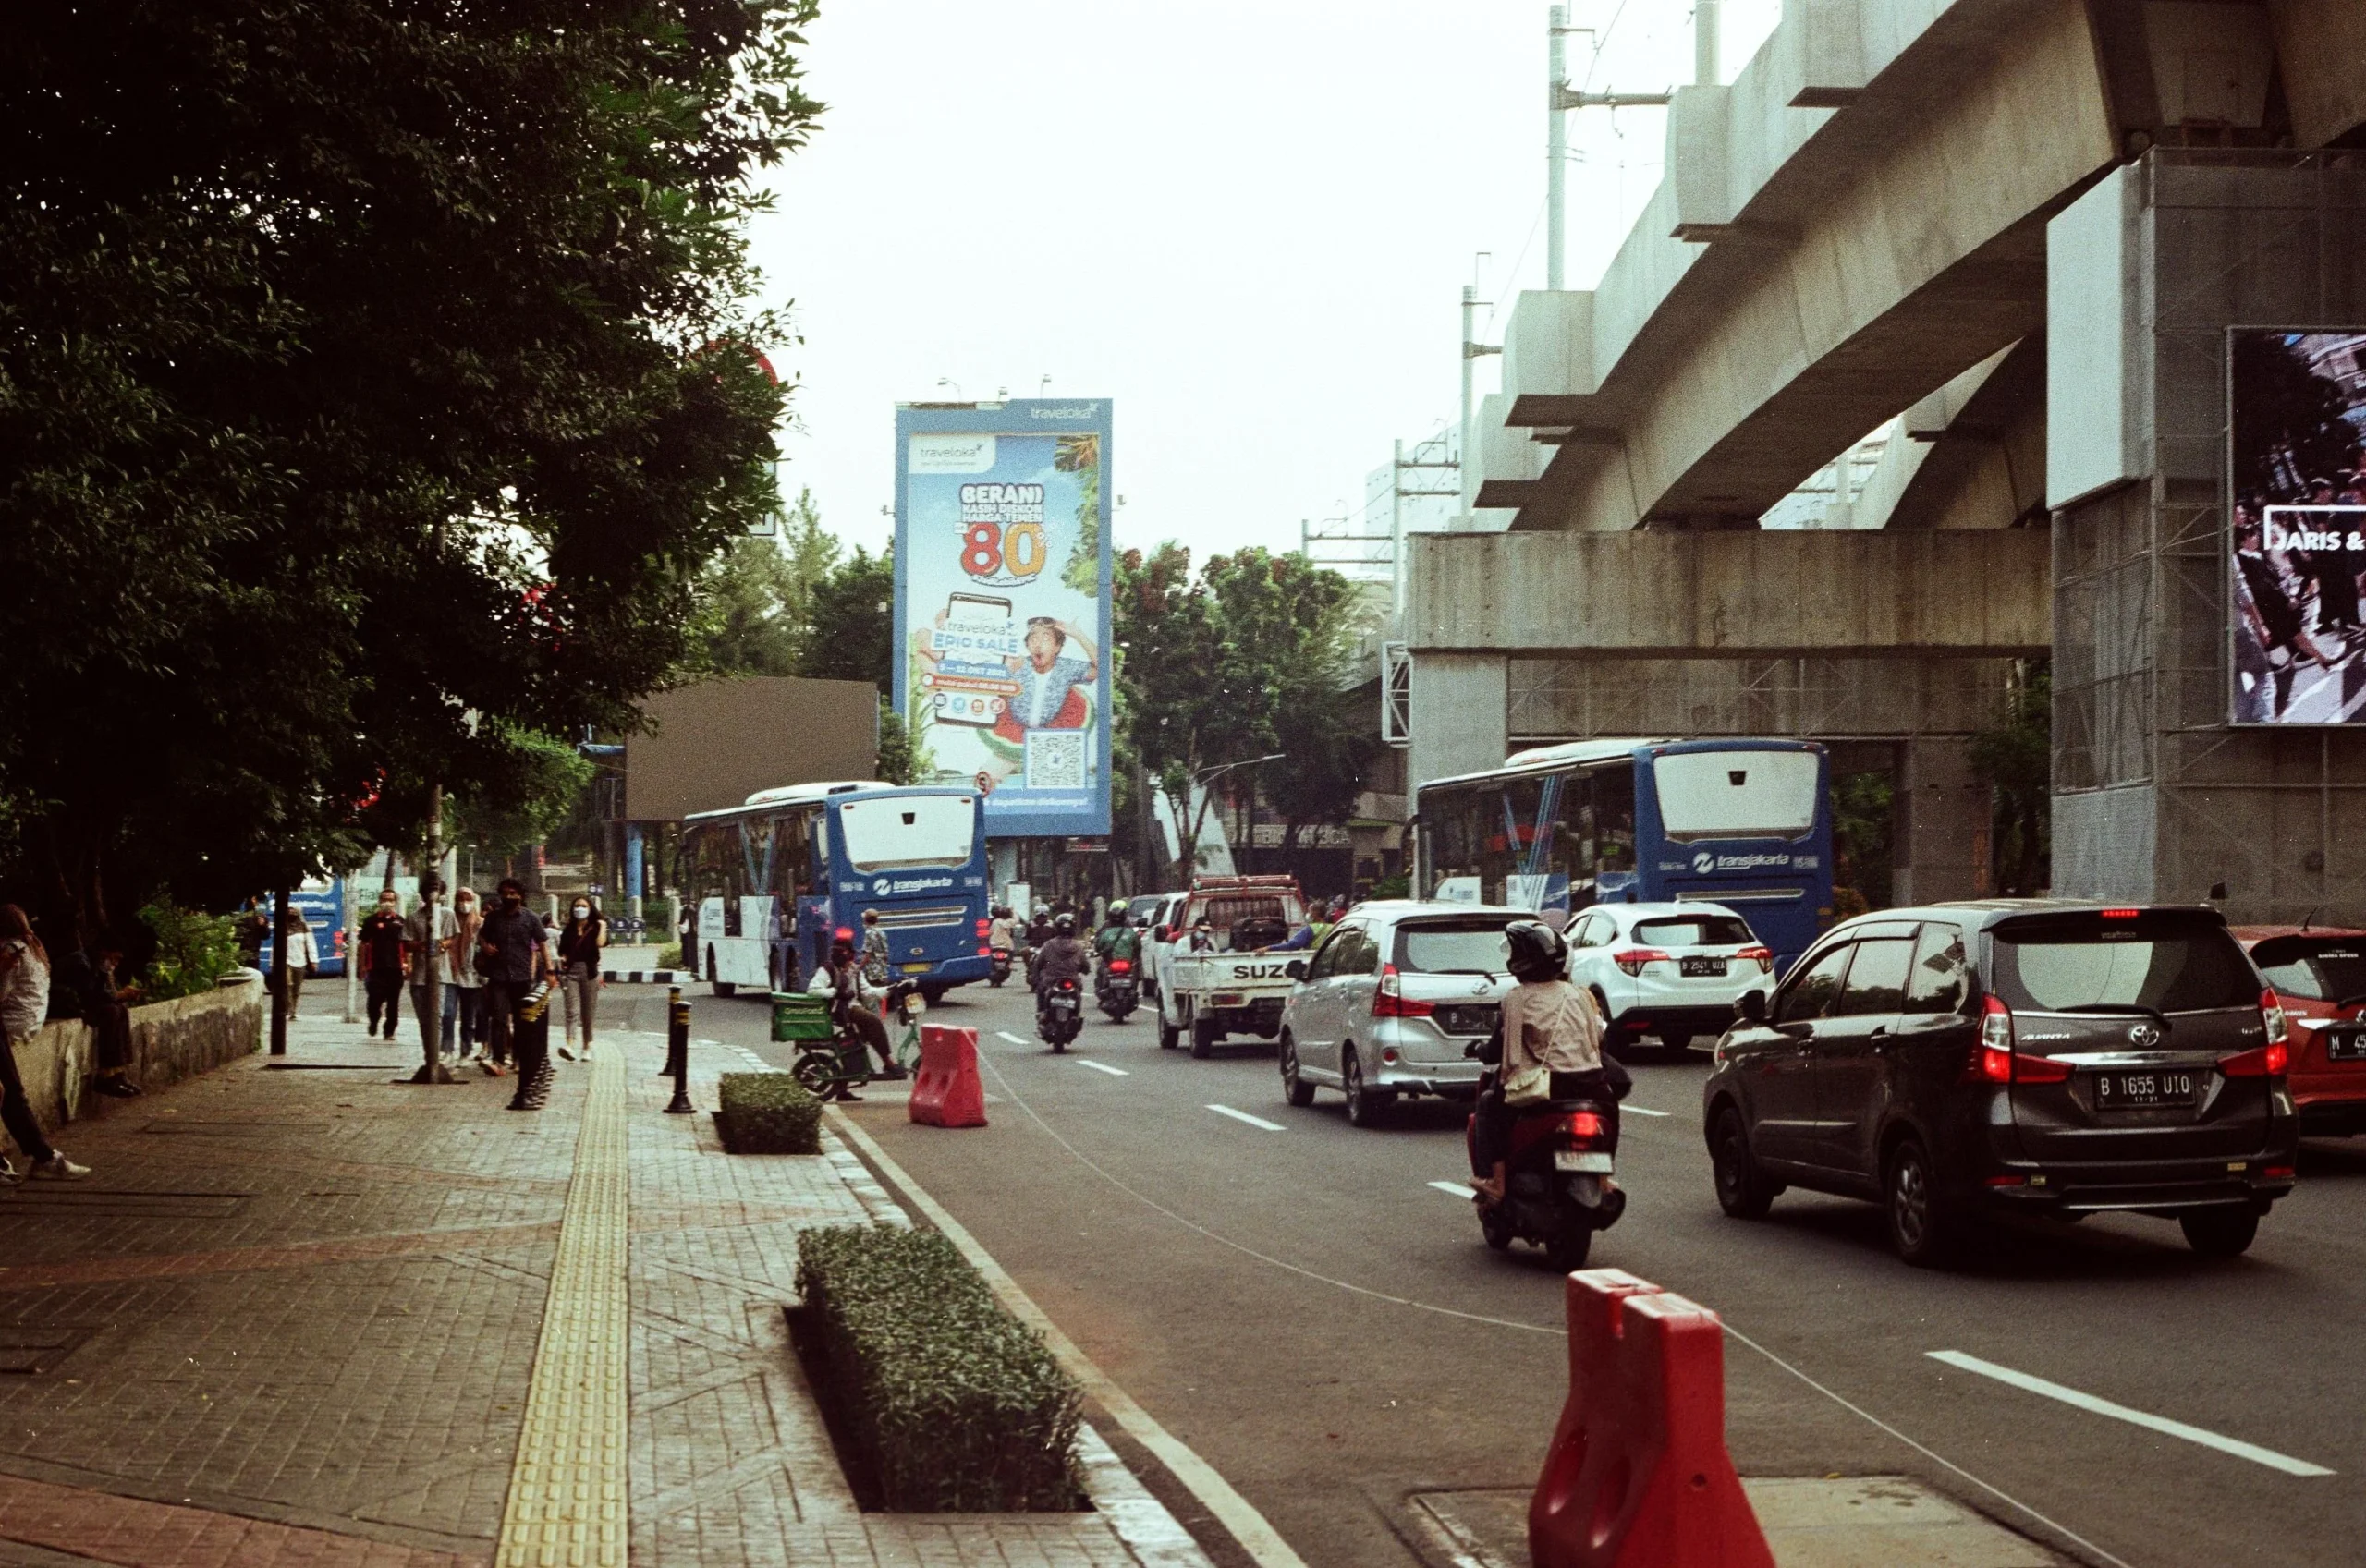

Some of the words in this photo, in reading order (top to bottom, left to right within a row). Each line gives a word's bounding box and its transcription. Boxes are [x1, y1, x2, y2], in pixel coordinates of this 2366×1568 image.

[1031, 407, 1092, 419] traveloka
[920, 446, 977, 458] traveloka
[961, 484, 1043, 504] BERANI
[947, 622, 1006, 636] traveloka
[933, 632, 972, 648] EPIC
[976, 638, 1018, 653] SALE
[2331, 1035, 2340, 1051] M
[2100, 1077, 2110, 1096] B
[2120, 1076, 2155, 1095] 1655
